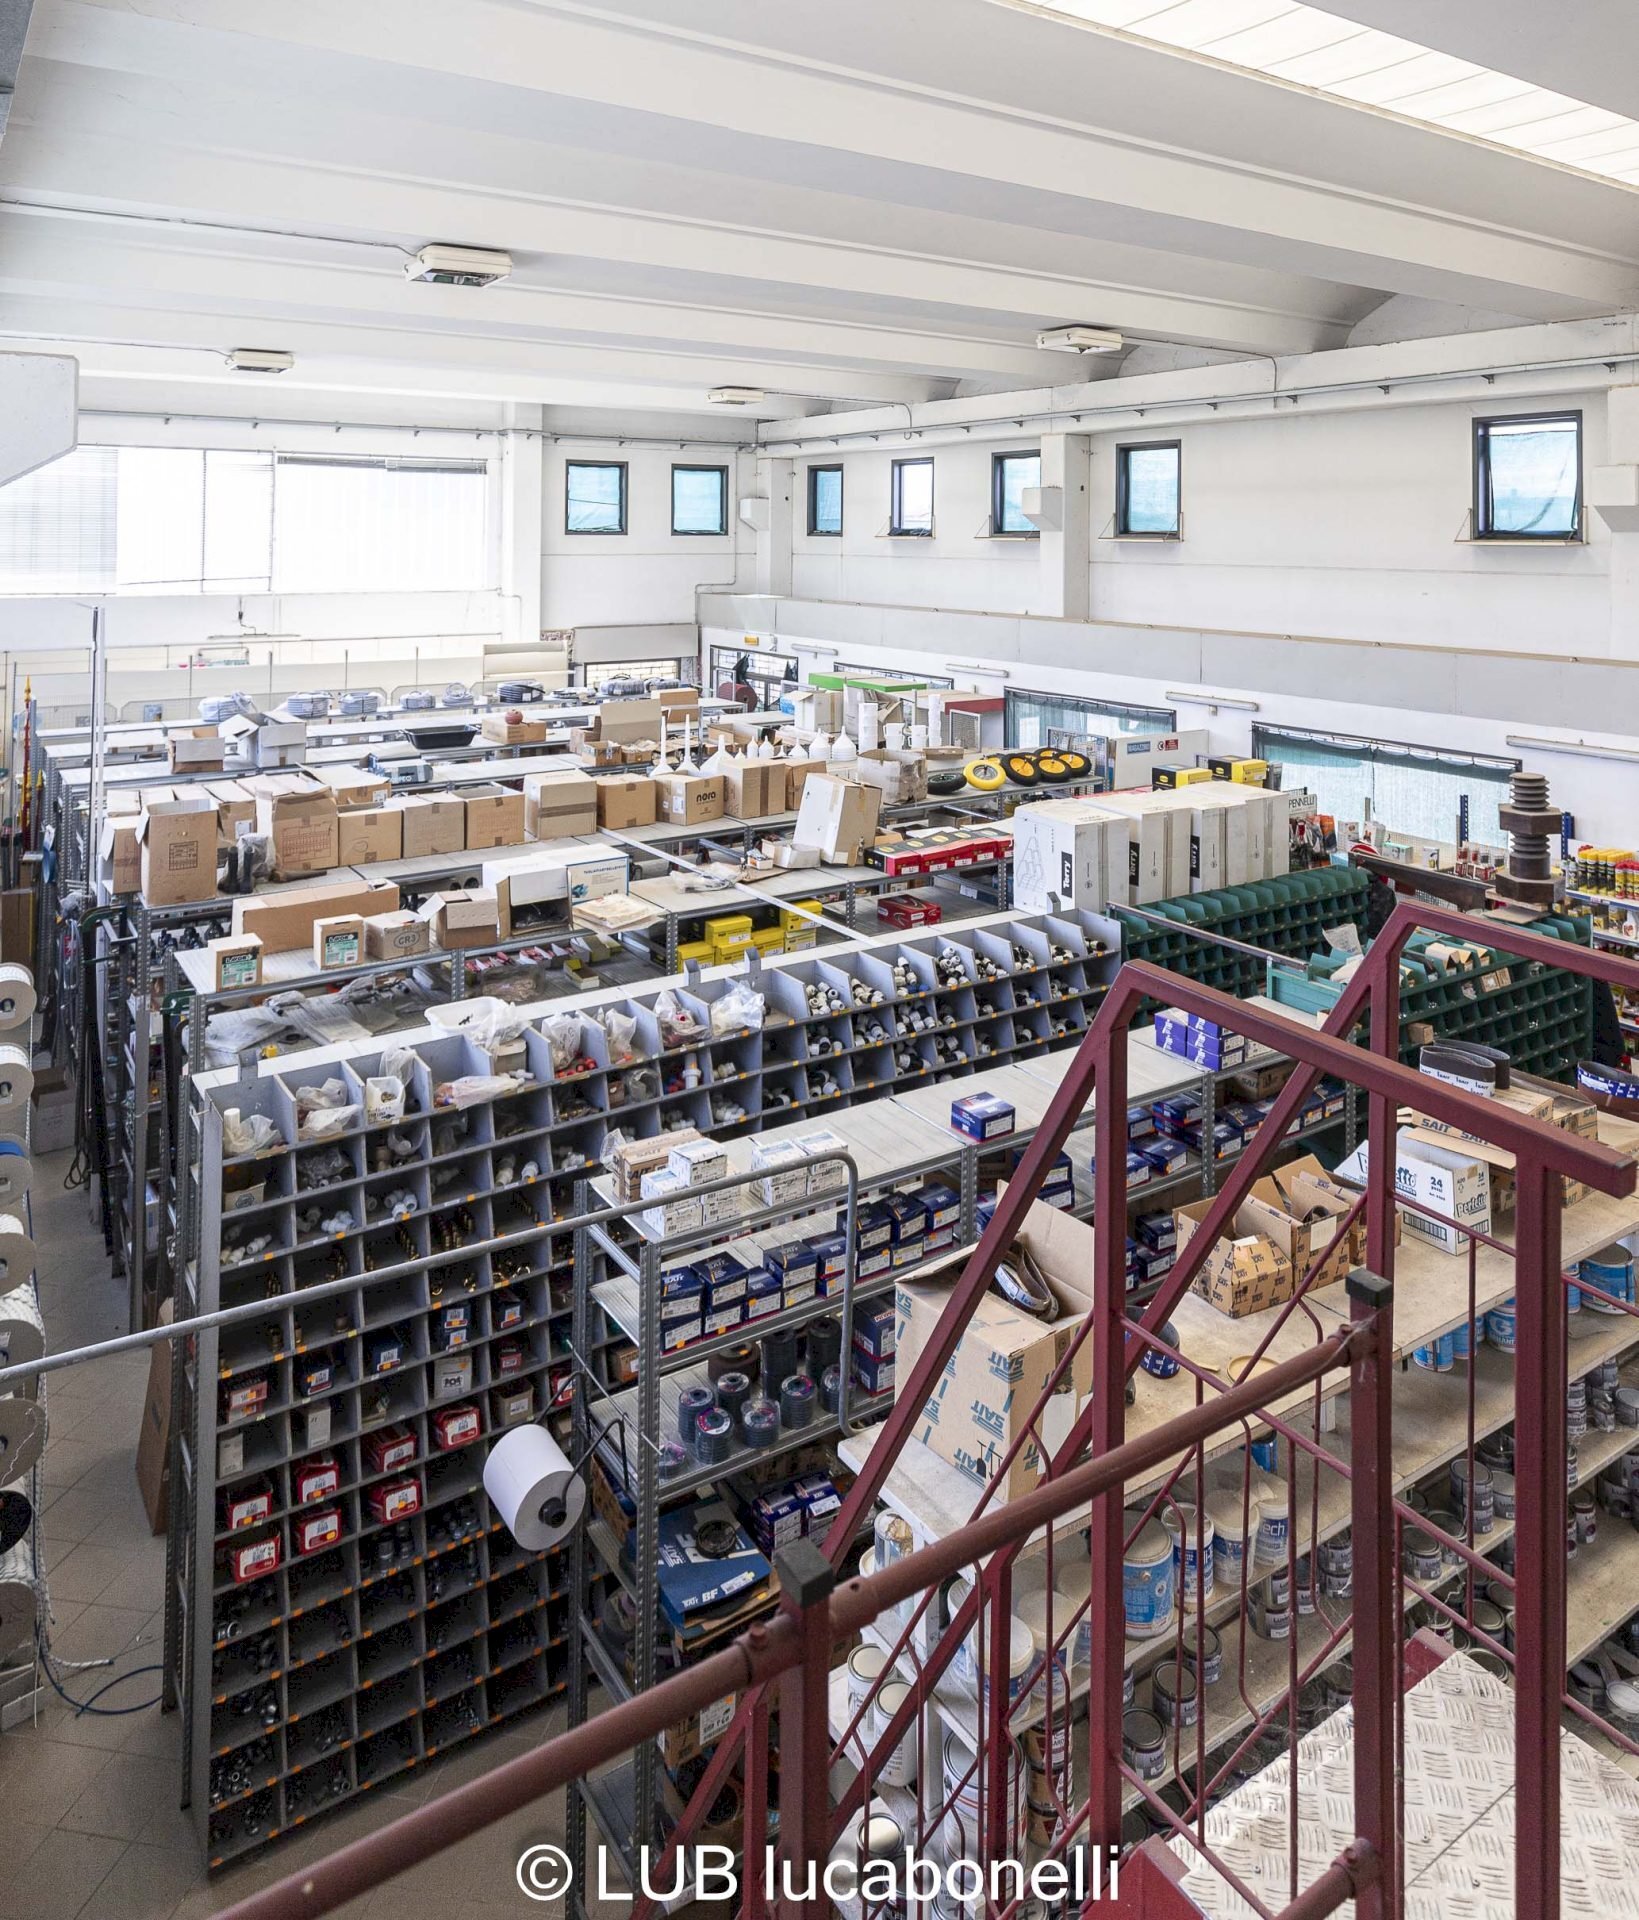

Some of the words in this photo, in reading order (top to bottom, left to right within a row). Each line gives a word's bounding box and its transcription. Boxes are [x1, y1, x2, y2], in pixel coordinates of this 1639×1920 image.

[696, 791, 717, 802] nora
[1062, 860, 1071, 888] Terry
[1421, 1118, 1452, 1133] SAIT
[1430, 1176, 1443, 1188] 24
[988, 1351, 1025, 1373] SAIT
[971, 1400, 1005, 1430] SAIT
[664, 1544, 684, 1565] SAIT
[702, 1588, 718, 1603] BF
